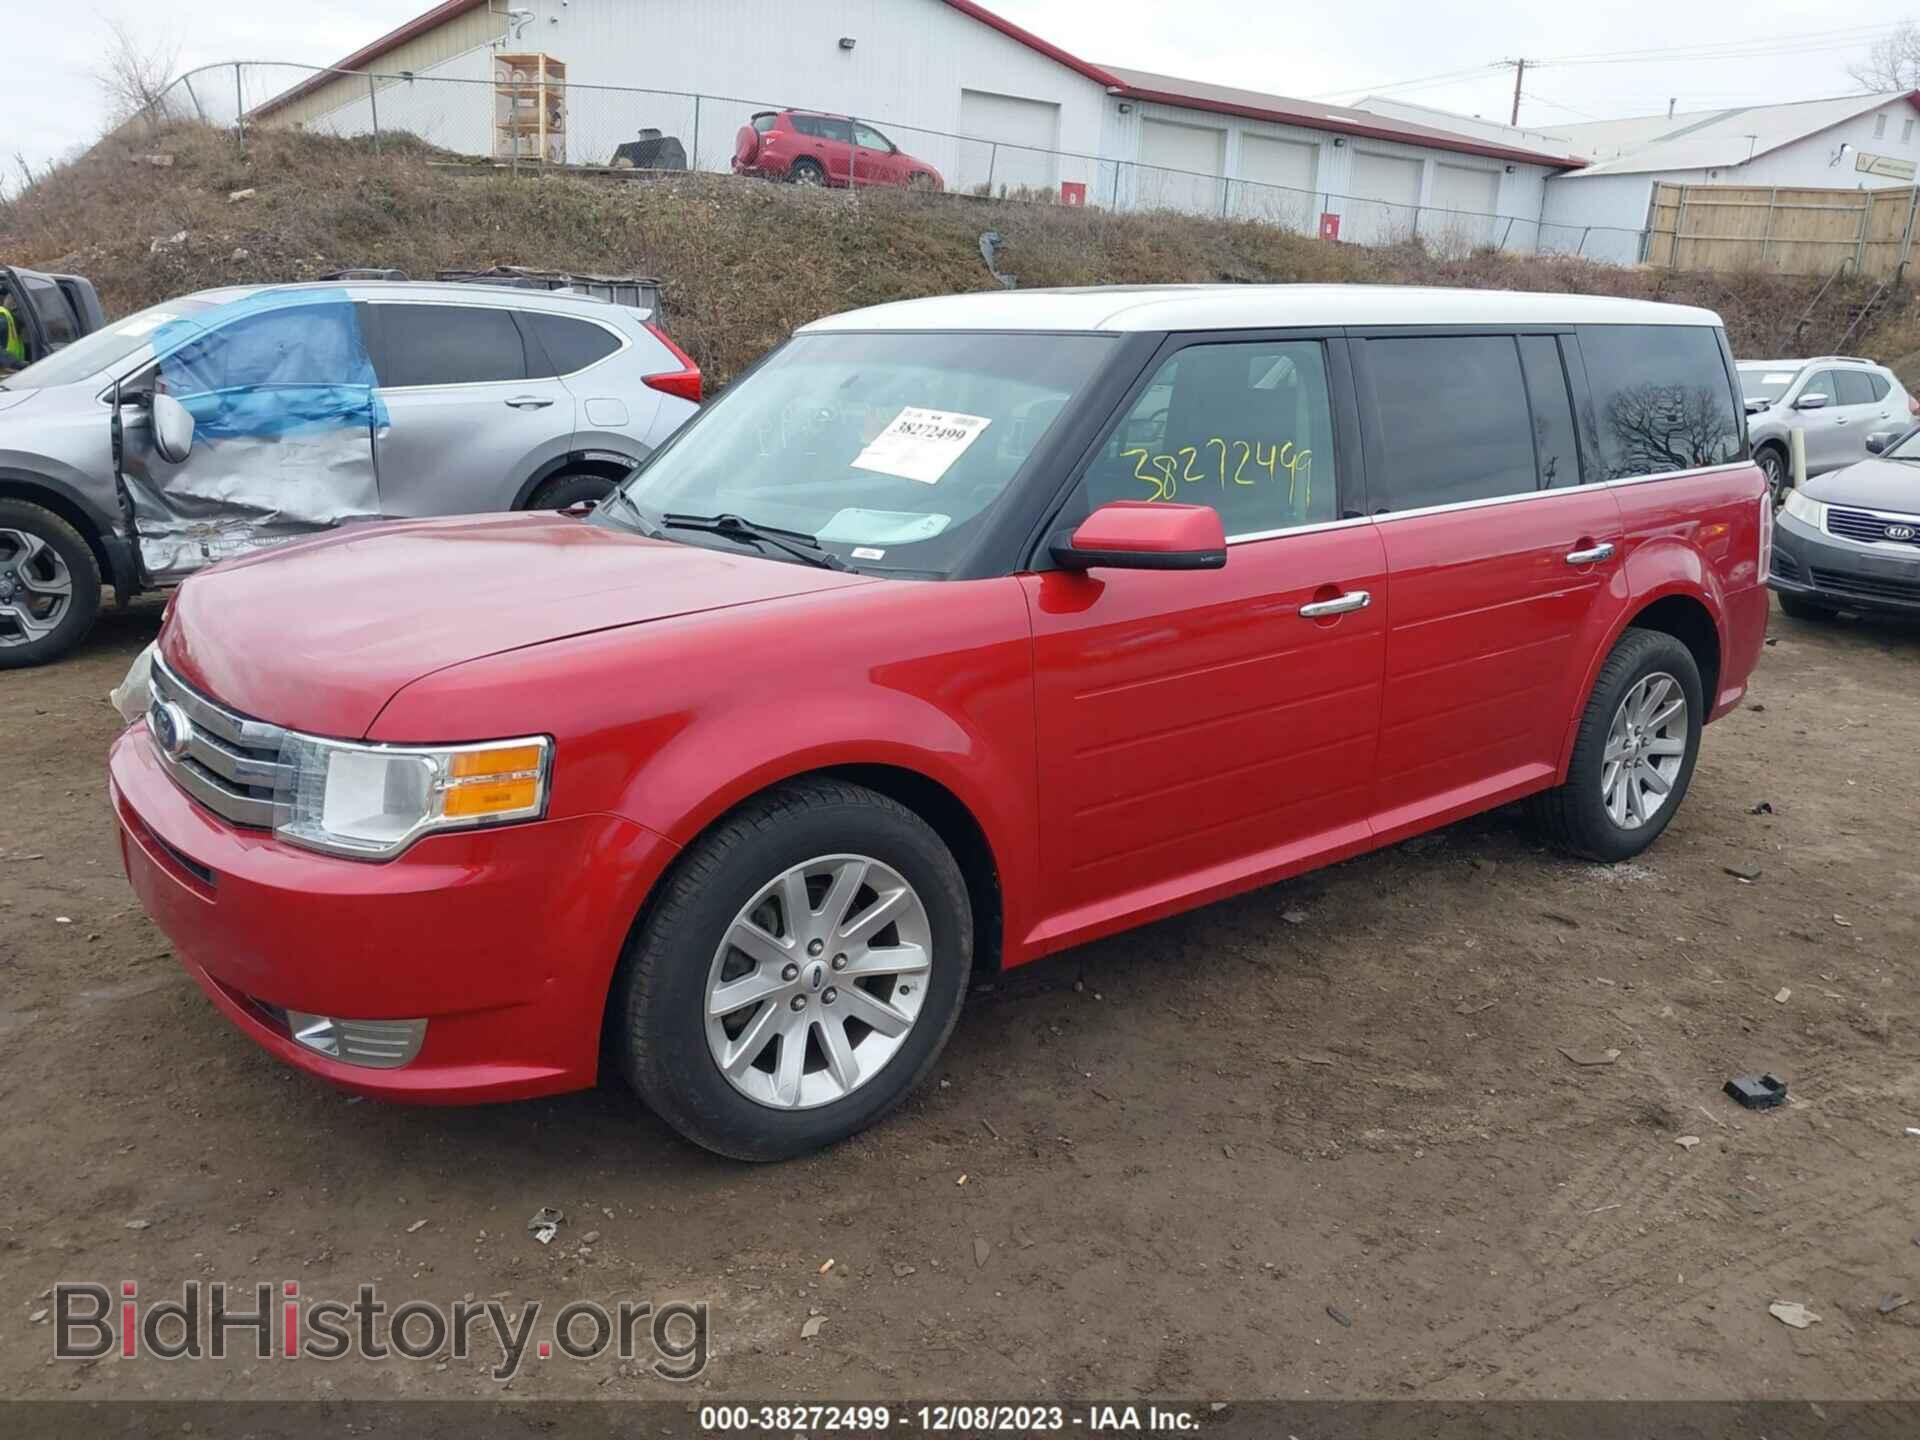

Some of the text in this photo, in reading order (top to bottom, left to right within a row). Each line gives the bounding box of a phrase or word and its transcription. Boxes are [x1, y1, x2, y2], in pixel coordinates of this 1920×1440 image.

[893, 421, 967, 441] 38272499
[1120, 438, 1313, 507] 38272499
[1888, 527, 1910, 537] KIA
